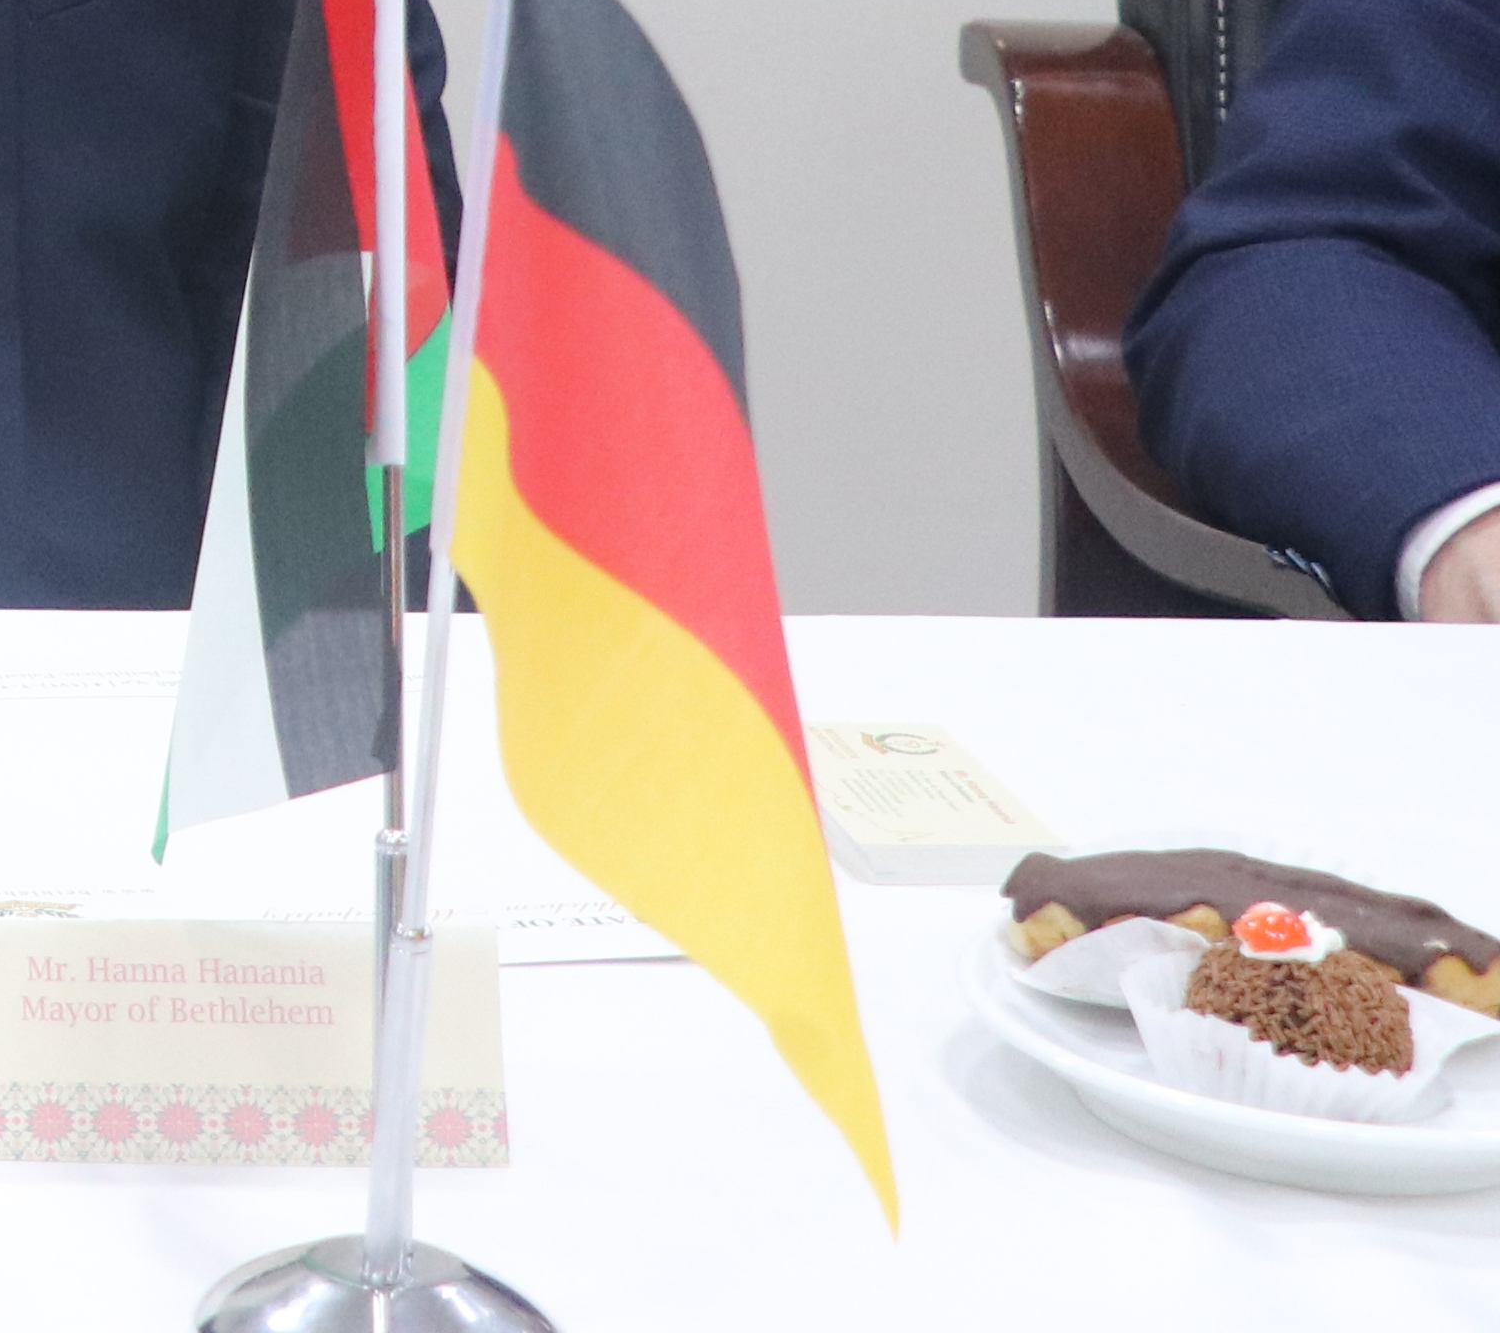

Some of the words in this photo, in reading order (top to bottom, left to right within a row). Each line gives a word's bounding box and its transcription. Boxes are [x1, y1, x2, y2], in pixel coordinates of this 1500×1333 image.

[562, 915, 646, 928] ATE
[26, 957, 76, 985] Mr.
[87, 957, 188, 985] Hanna
[198, 958, 326, 987] Hanania
[20, 995, 117, 1028] Mayor
[127, 994, 161, 1024] of
[169, 995, 335, 1026] Bethlehem
